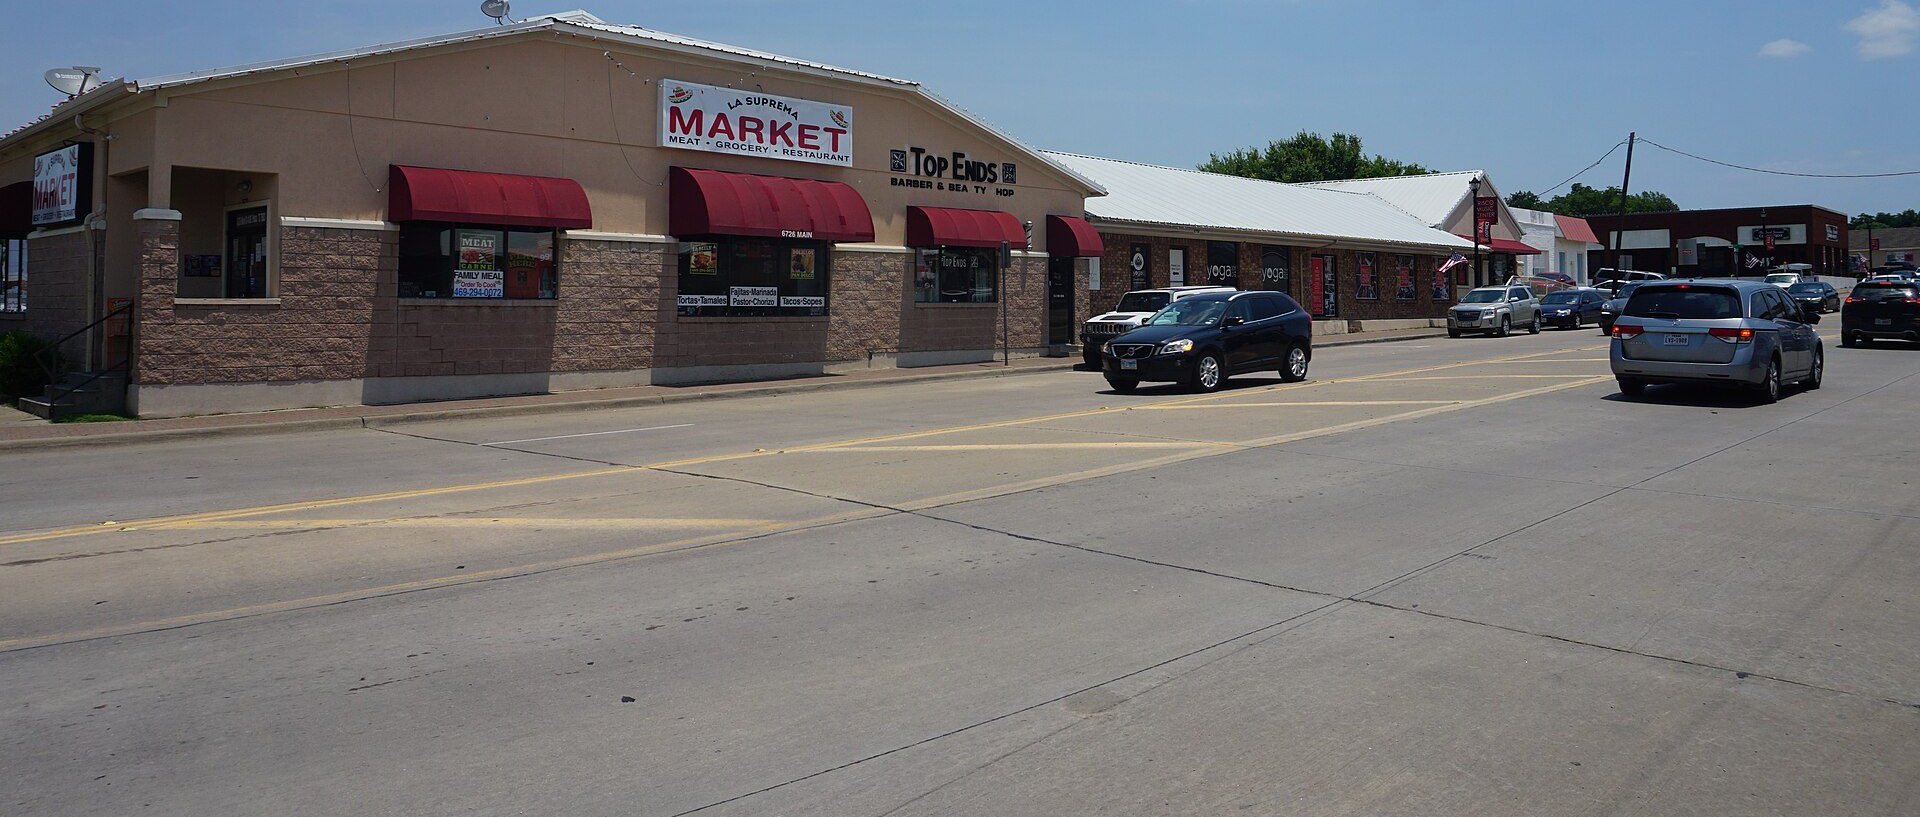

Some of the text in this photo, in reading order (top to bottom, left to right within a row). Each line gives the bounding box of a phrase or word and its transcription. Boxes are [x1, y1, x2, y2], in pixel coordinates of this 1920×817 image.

[728, 96, 799, 121] LA SUPREMA
[669, 105, 847, 153] MARKET
[669, 135, 850, 163] MEAT GROCERY RESTAURANT
[910, 146, 998, 184] TOP ENDS
[33, 172, 76, 211] MARKET
[890, 177, 933, 190] BARBER
[937, 181, 945, 190] &
[462, 238, 494, 248] MEAT
[796, 231, 813, 239] MAIN
[953, 256, 967, 268] ENDS
[454, 271, 503, 280] FAMILY MEAL
[1206, 264, 1232, 281] yoga
[1261, 267, 1284, 282] yoga
